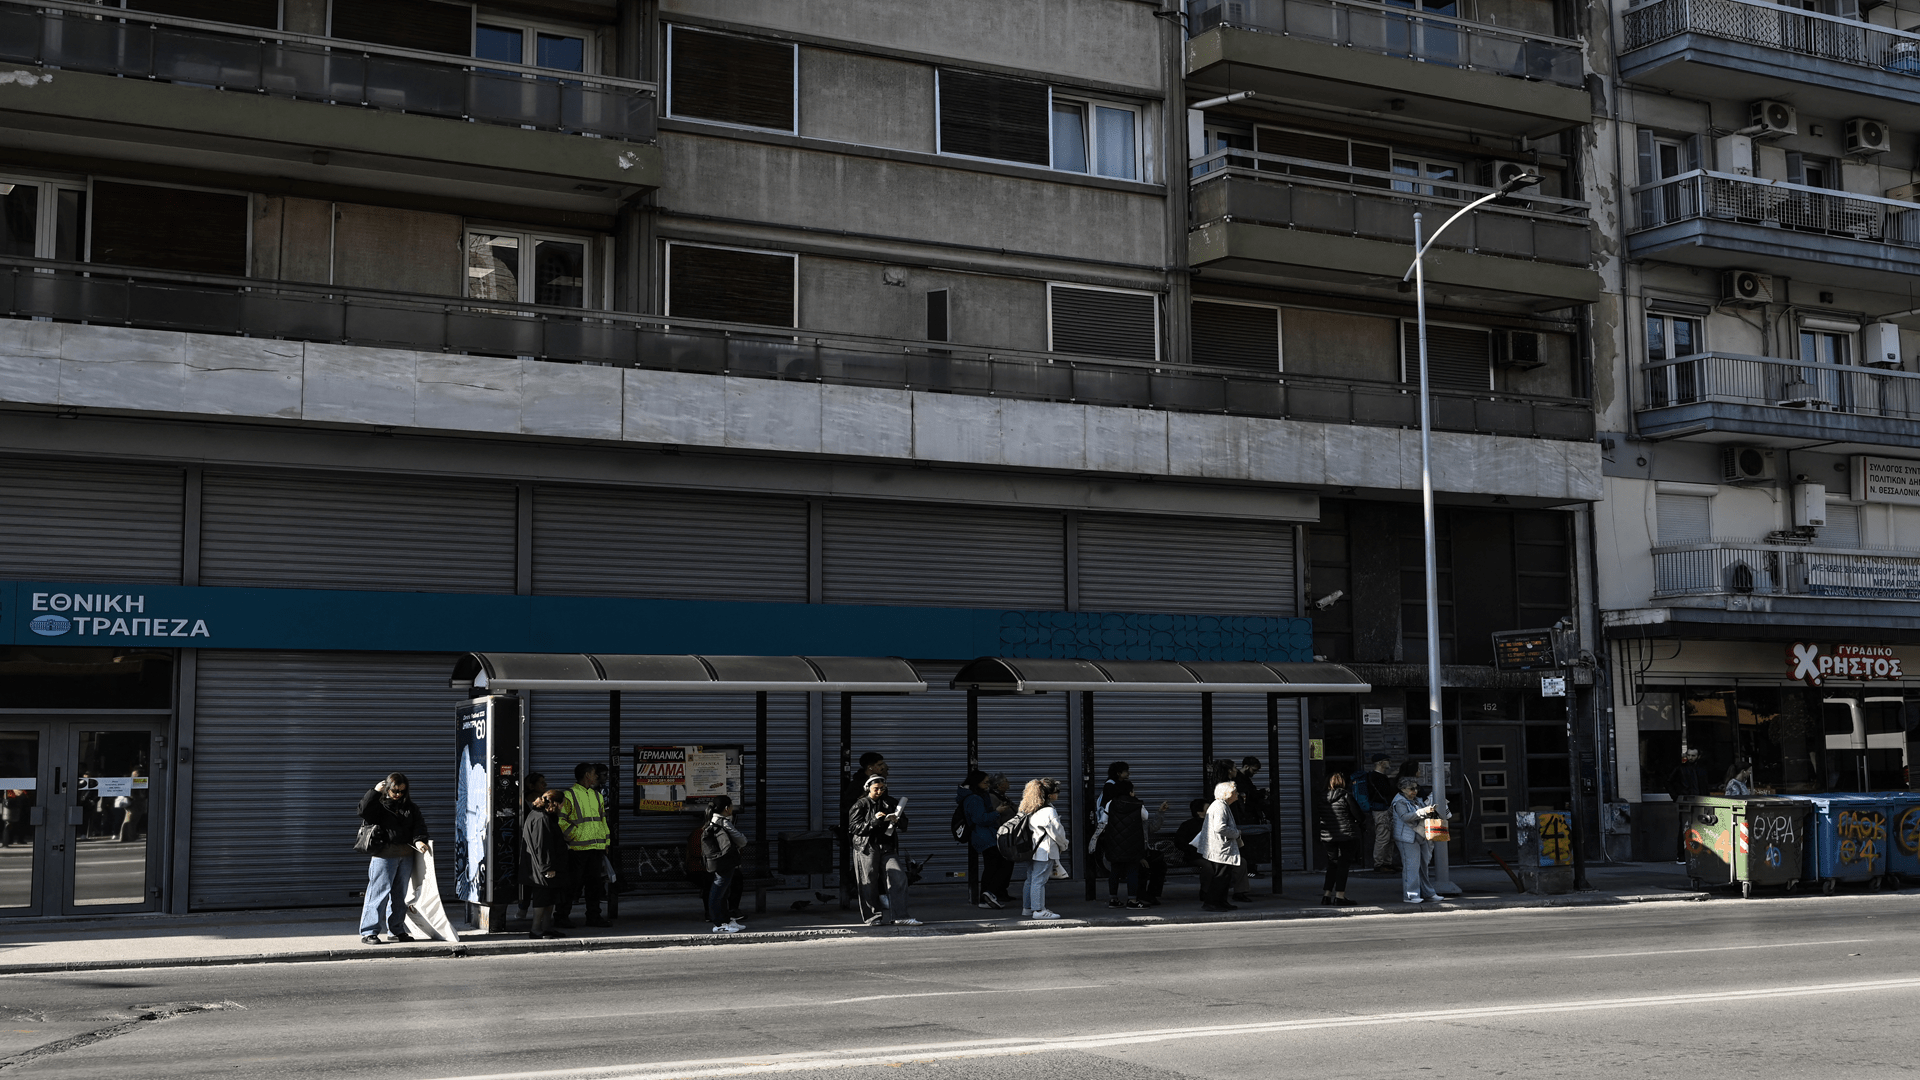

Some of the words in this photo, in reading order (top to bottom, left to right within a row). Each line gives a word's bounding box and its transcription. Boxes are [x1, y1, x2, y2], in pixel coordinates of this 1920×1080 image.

[1869, 463, 1903, 474] ΣΥΛΛΟΓΟΣ
[1869, 474, 1907, 485] ΠΟΛΙΤΙΚΩΝ
[32, 592, 145, 613] ΕΘΝΙΚΗ
[72, 616, 211, 638] ΤΡΑΠΕΖΑ
[1838, 645, 1893, 657] ΓΥΡΑΔΙΚΟ
[1793, 643, 1903, 685] ΧΡΗΣΤΟΣ
[1482, 702, 1498, 711] 152
[638, 750, 685, 760] ΓΕΡΜΑΝΙΚΑ
[647, 763, 685, 776] ΑΛΜΑ
[1753, 814, 1795, 843] ΘΥΡΑ
[1838, 810, 1887, 841] ΠΑΟΚ
[1541, 815, 1565, 862] 4
